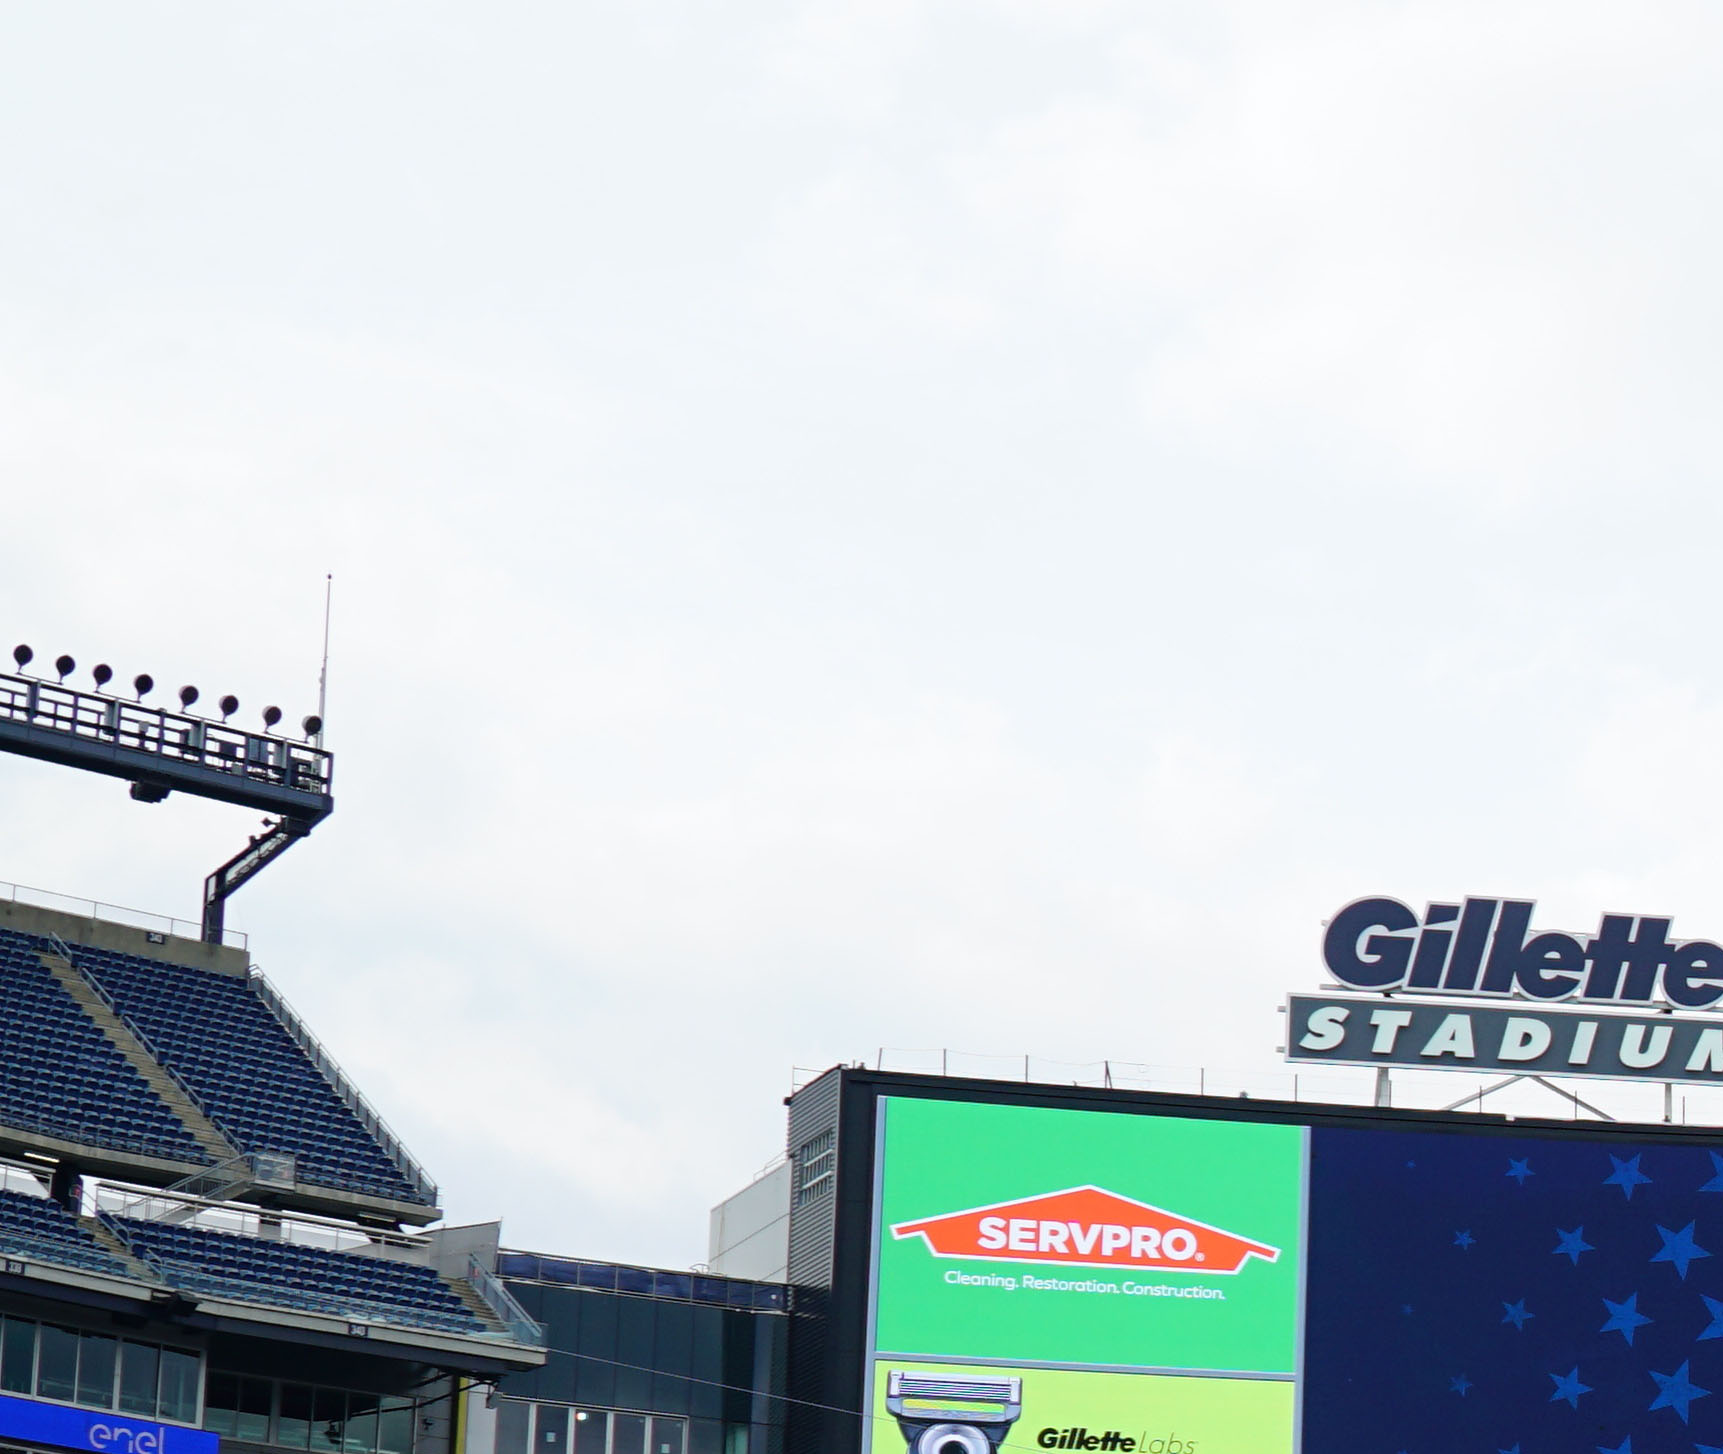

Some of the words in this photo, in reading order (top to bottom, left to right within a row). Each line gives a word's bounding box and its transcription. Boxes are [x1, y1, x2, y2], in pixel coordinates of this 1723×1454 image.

[944, 1271, 1019, 1290] Cleaning.
[1022, 1275, 1120, 1293] Restoration.
[1123, 1281, 1226, 1300] Construction.
